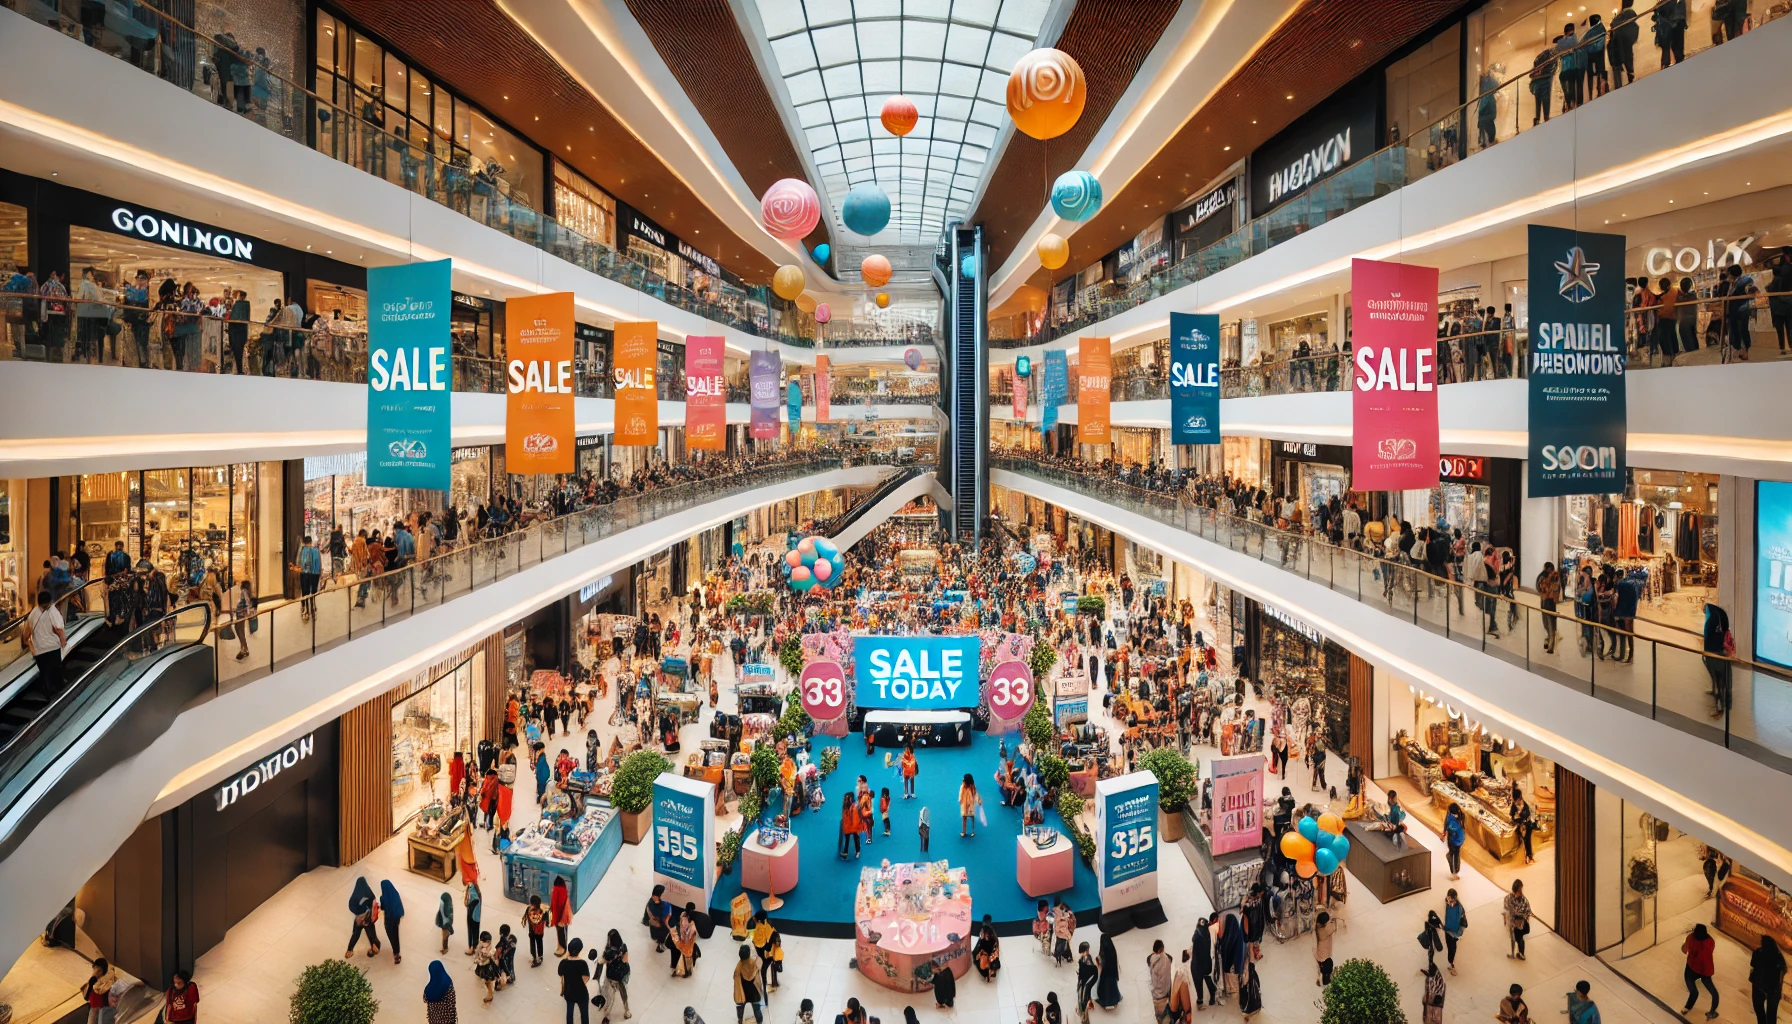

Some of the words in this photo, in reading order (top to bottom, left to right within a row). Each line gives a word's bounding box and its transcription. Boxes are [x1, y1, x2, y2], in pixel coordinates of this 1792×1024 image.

[371, 347, 446, 392] SALE
[508, 359, 572, 394] SALE
[613, 367, 654, 390] SALE
[1172, 362, 1219, 387] SALE
[1356, 346, 1433, 392] SALE
[687, 375, 724, 396] SALE
[869, 648, 963, 679] SALE
[804, 677, 843, 707] 33
[872, 678, 963, 700] TODAY
[992, 677, 1030, 706] 33
